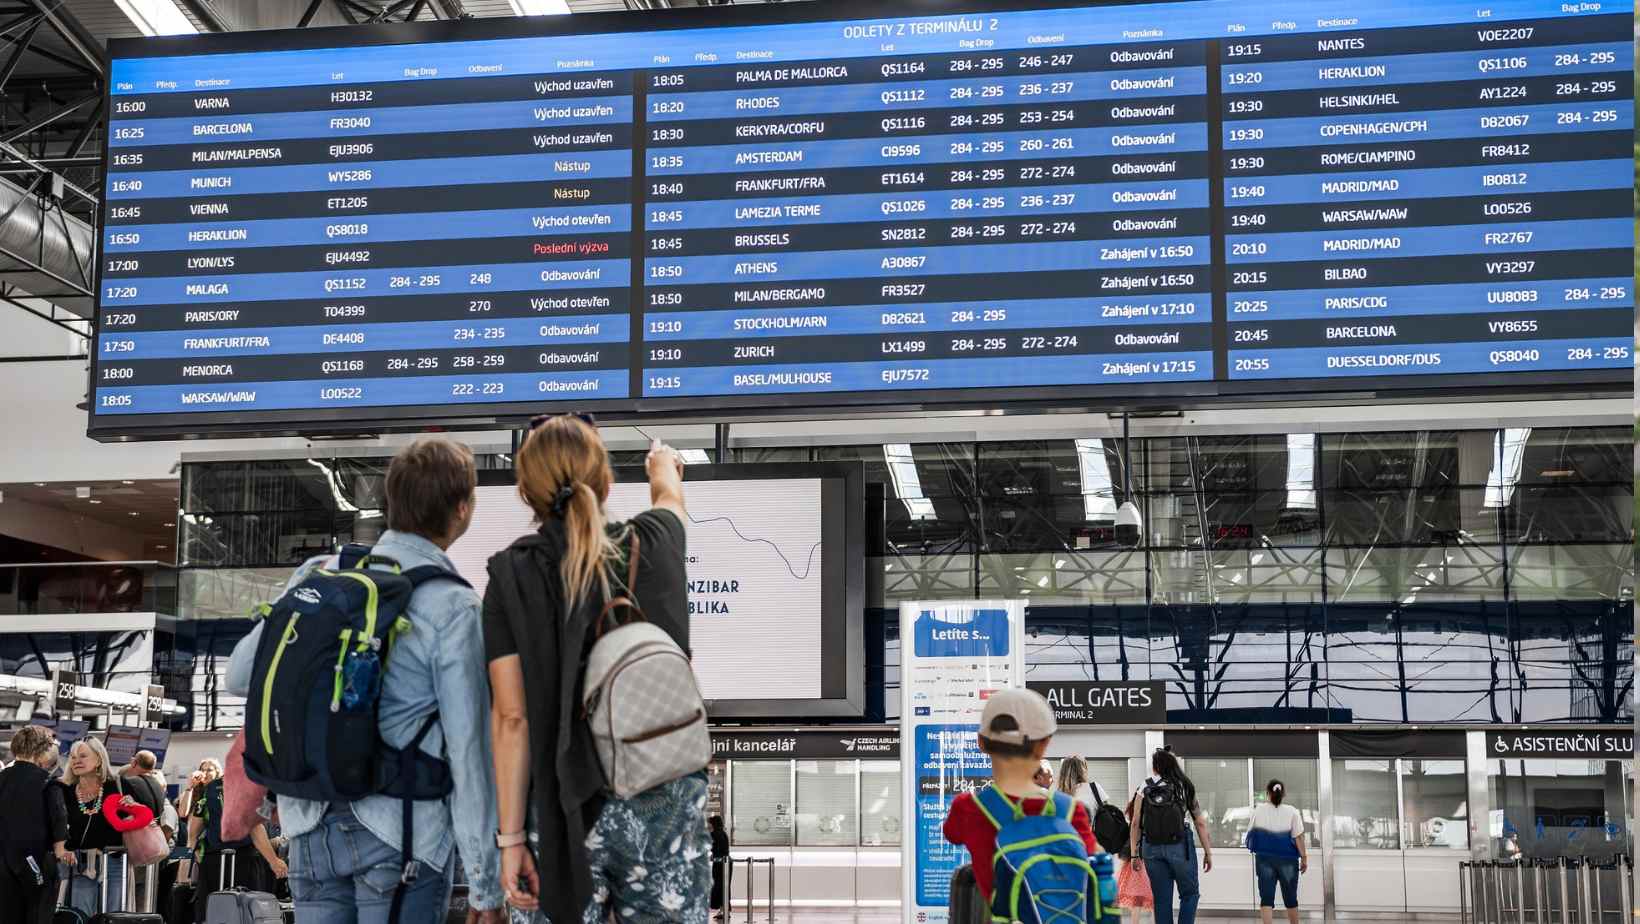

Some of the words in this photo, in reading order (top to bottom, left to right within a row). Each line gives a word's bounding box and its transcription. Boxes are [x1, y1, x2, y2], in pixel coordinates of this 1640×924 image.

[1561, 4, 1580, 14] Bag
[1580, 2, 1601, 12] Drop
[843, 23, 893, 38] ODLETY
[896, 24, 905, 36] Z
[909, 18, 983, 35] TERMINÁLU
[989, 18, 998, 31] 2
[1228, 44, 1261, 56] 19:15
[1318, 38, 1365, 52] NANTES
[654, 74, 684, 86] 18:05
[736, 70, 772, 82] PALMA
[774, 69, 789, 80] DE
[791, 66, 848, 79] MALLORCA
[881, 62, 925, 77] QS1164
[1229, 72, 1262, 84] 19:20
[1319, 65, 1385, 80] HERAKLION
[1478, 57, 1527, 73] QS1106
[116, 101, 146, 113] 16:00
[194, 97, 230, 109] VARNA
[331, 90, 372, 102] H30132
[534, 80, 571, 94] Východ
[573, 78, 614, 90] uzavřen
[653, 102, 684, 114] 18:20
[736, 96, 780, 110] RHODES
[881, 90, 925, 104] QS1112
[1229, 100, 1263, 113] 19:30
[1320, 93, 1400, 108] HELSINKI/HEL
[1480, 86, 1527, 99] AY1224
[115, 128, 144, 139] 16:25
[193, 123, 253, 135] BARCELONA
[330, 117, 371, 128] FR3040
[653, 128, 684, 140] 18:30
[736, 122, 824, 136] KERKYRA/CORFU
[881, 117, 925, 132] QS1116
[1230, 128, 1264, 141] 19:30
[1320, 120, 1427, 136] COPENHAGEN/CPH
[1480, 114, 1529, 128] D82067
[113, 154, 143, 165] 16:35
[192, 148, 282, 162] MILAN/MALPENSA
[329, 143, 373, 158] EJU3906
[652, 156, 683, 168] 18:35
[735, 150, 802, 164] AMSTERDAM
[881, 144, 920, 157] CI9596
[1230, 157, 1264, 169] 19:30
[1321, 150, 1416, 165] ROME/CIAMPINO
[1482, 144, 1530, 157] FR8412
[112, 180, 142, 192] 16:40
[191, 177, 231, 188] MUNICH
[328, 170, 372, 182] WY5286
[554, 161, 591, 173] Nástup
[652, 183, 683, 195] 18:40
[736, 177, 826, 192] FRANKFURT/FRA
[881, 172, 924, 184] ET1614
[1232, 186, 1265, 198] 19:40
[1322, 179, 1399, 193] MADRID/MAD
[1483, 173, 1527, 186] IB0812
[111, 207, 140, 218] 16:45
[190, 203, 229, 215] VIENNA
[328, 196, 368, 209] ET1205
[652, 210, 682, 222] 18:45
[735, 206, 782, 219] LAMEZIA
[784, 204, 821, 216] TERME
[881, 200, 926, 215] QS1026
[1232, 214, 1266, 226] 19:40
[1322, 208, 1408, 222] WARSAW/WAW
[110, 233, 140, 245] 16:50
[188, 229, 247, 241] HERAKLION
[326, 224, 368, 238] QS8018
[652, 238, 682, 250] 18:45
[735, 233, 790, 246] BRUSSELS
[881, 228, 926, 240] SN2812
[1232, 242, 1266, 255] 20:10
[1323, 237, 1401, 251] MADRID/MAD
[1485, 231, 1533, 245] FR2767
[108, 260, 139, 272] 17:00
[188, 256, 234, 268] LYON/LYS
[326, 251, 370, 265] EJU4492
[534, 242, 576, 254] Poslední
[579, 242, 609, 254] výzva
[651, 266, 682, 277] 18:50
[734, 262, 778, 274] ATHENS
[881, 256, 926, 268] A30867
[1101, 247, 1148, 262] Zahájení
[1150, 249, 1157, 258] v
[1160, 245, 1194, 258] 16:50
[1233, 272, 1267, 284] 20:15
[1324, 268, 1367, 280] BILBAO
[1486, 261, 1535, 274] VY3297
[107, 287, 137, 298] 17:20
[186, 284, 229, 295] MALAGA
[324, 278, 366, 292] QS1152
[470, 273, 492, 284] 248
[651, 293, 682, 305] 18:50
[734, 288, 825, 302] MILAN/BERGAMO
[882, 284, 925, 296] FR3527
[1234, 300, 1268, 312] 20:25
[1325, 296, 1387, 309] PARIS/CDG
[1488, 290, 1538, 303] UU8083
[105, 314, 136, 325] 17:20
[185, 310, 240, 322] PARIS/ORY
[469, 300, 491, 312] 270
[650, 321, 682, 333] 19:10
[734, 316, 827, 330] STOCKHOLM/ARN
[882, 312, 926, 325] D82621
[104, 340, 135, 352] 17:50
[184, 336, 270, 349] FRANKFURT/FRA
[323, 332, 364, 344] DE4408
[1235, 329, 1268, 342] 20:45
[1326, 325, 1396, 339] BARCELONA
[1488, 320, 1538, 333] VY8655
[650, 348, 681, 360] 19:10
[734, 346, 774, 358] ZURICH
[882, 340, 926, 353] LX1499
[1236, 358, 1269, 370] 20:55
[1327, 353, 1441, 368] DUESSELDORF/DUS
[1490, 349, 1539, 365] QS8040
[103, 368, 134, 379] 18:00
[183, 364, 233, 376] MENORCA
[322, 360, 364, 374] QS1168
[650, 376, 680, 389] 19:15
[734, 372, 832, 386] BASEL/MULHOUSE
[882, 369, 929, 384] EJU7572
[102, 395, 132, 406] 18:05
[182, 391, 256, 404] WARSAW/WAW
[932, 628, 969, 640] Letíte
[59, 683, 75, 699] 258
[1047, 688, 1083, 707] ALL
[1088, 688, 1152, 707] GATES
[148, 696, 162, 712] 259
[1087, 710, 1094, 719] 2
[734, 738, 796, 752] kancelář
[1513, 734, 1600, 752] ASISTENČNÍ
[1604, 737, 1633, 752] SLU
